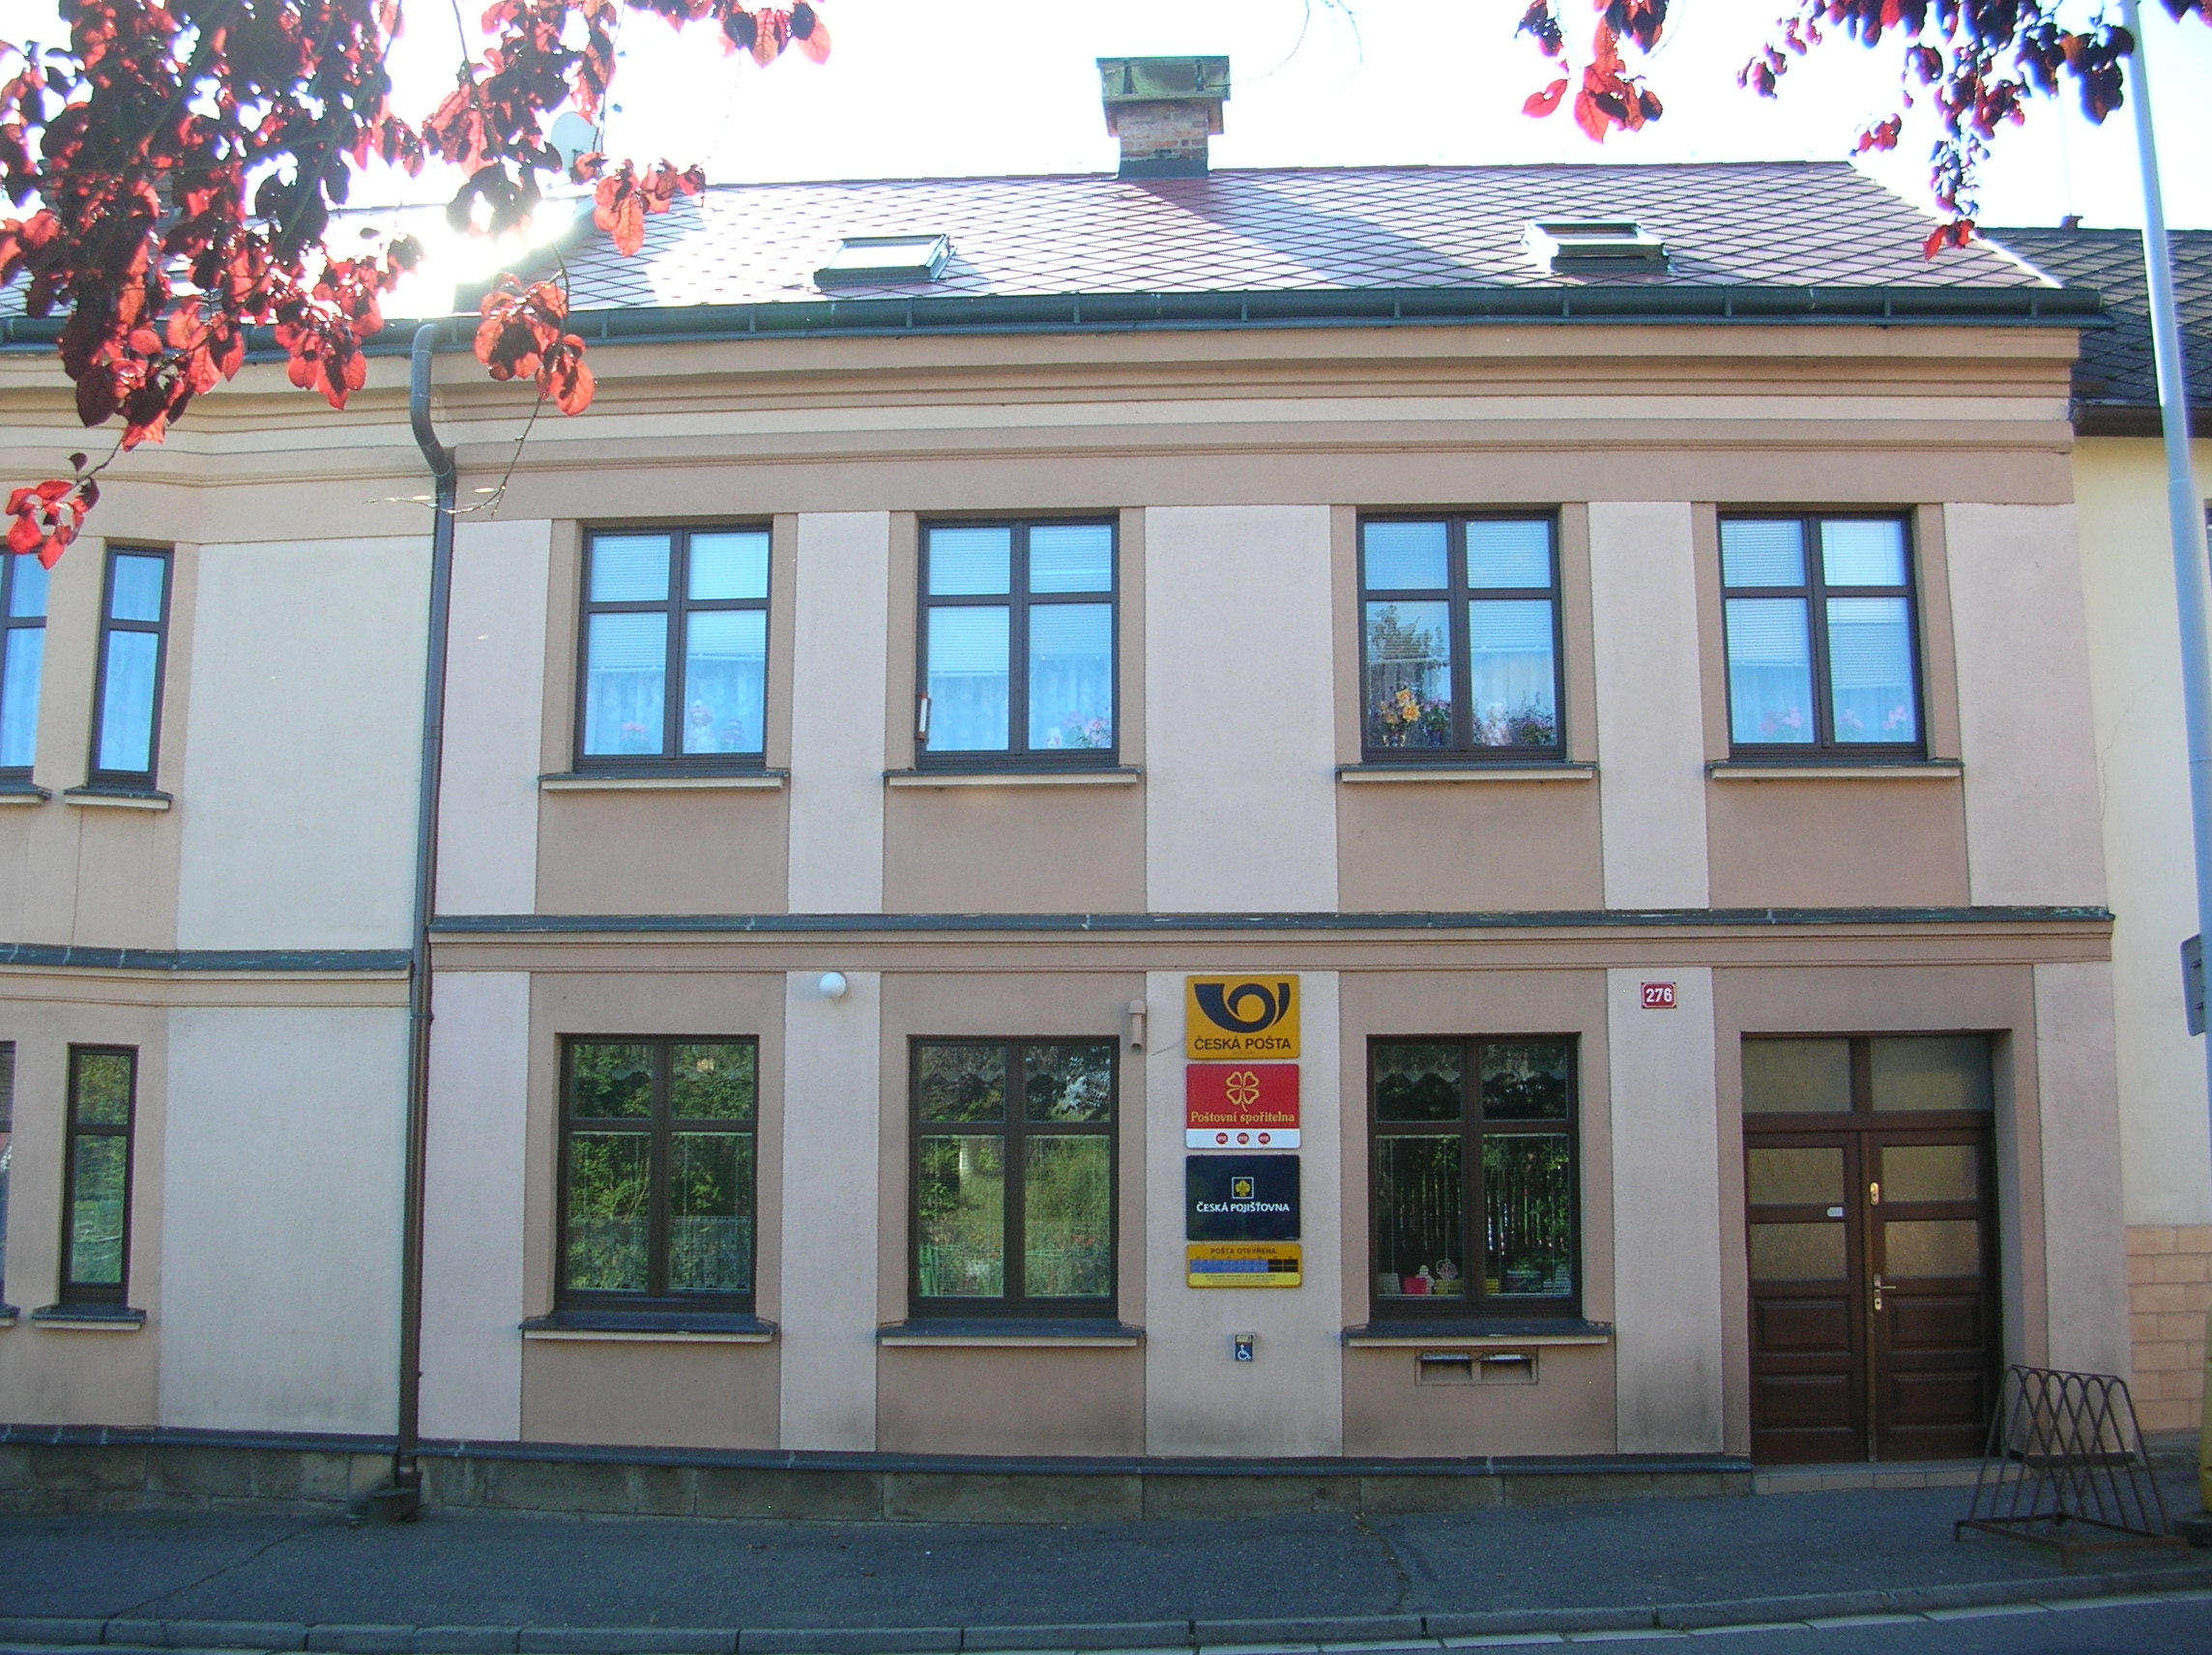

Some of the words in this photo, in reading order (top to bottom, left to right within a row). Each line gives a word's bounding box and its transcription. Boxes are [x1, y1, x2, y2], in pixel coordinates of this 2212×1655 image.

[1645, 987, 1673, 1002] 276
[1194, 1035, 1240, 1050] ČESKÁ
[1245, 1035, 1292, 1050] POŠTA
[1190, 1111, 1237, 1122] Poštovní
[1239, 1111, 1295, 1124] spořitelna
[1196, 1201, 1229, 1212] ČESKÁ
[1230, 1201, 1290, 1213] POJIŠŤOVNA
